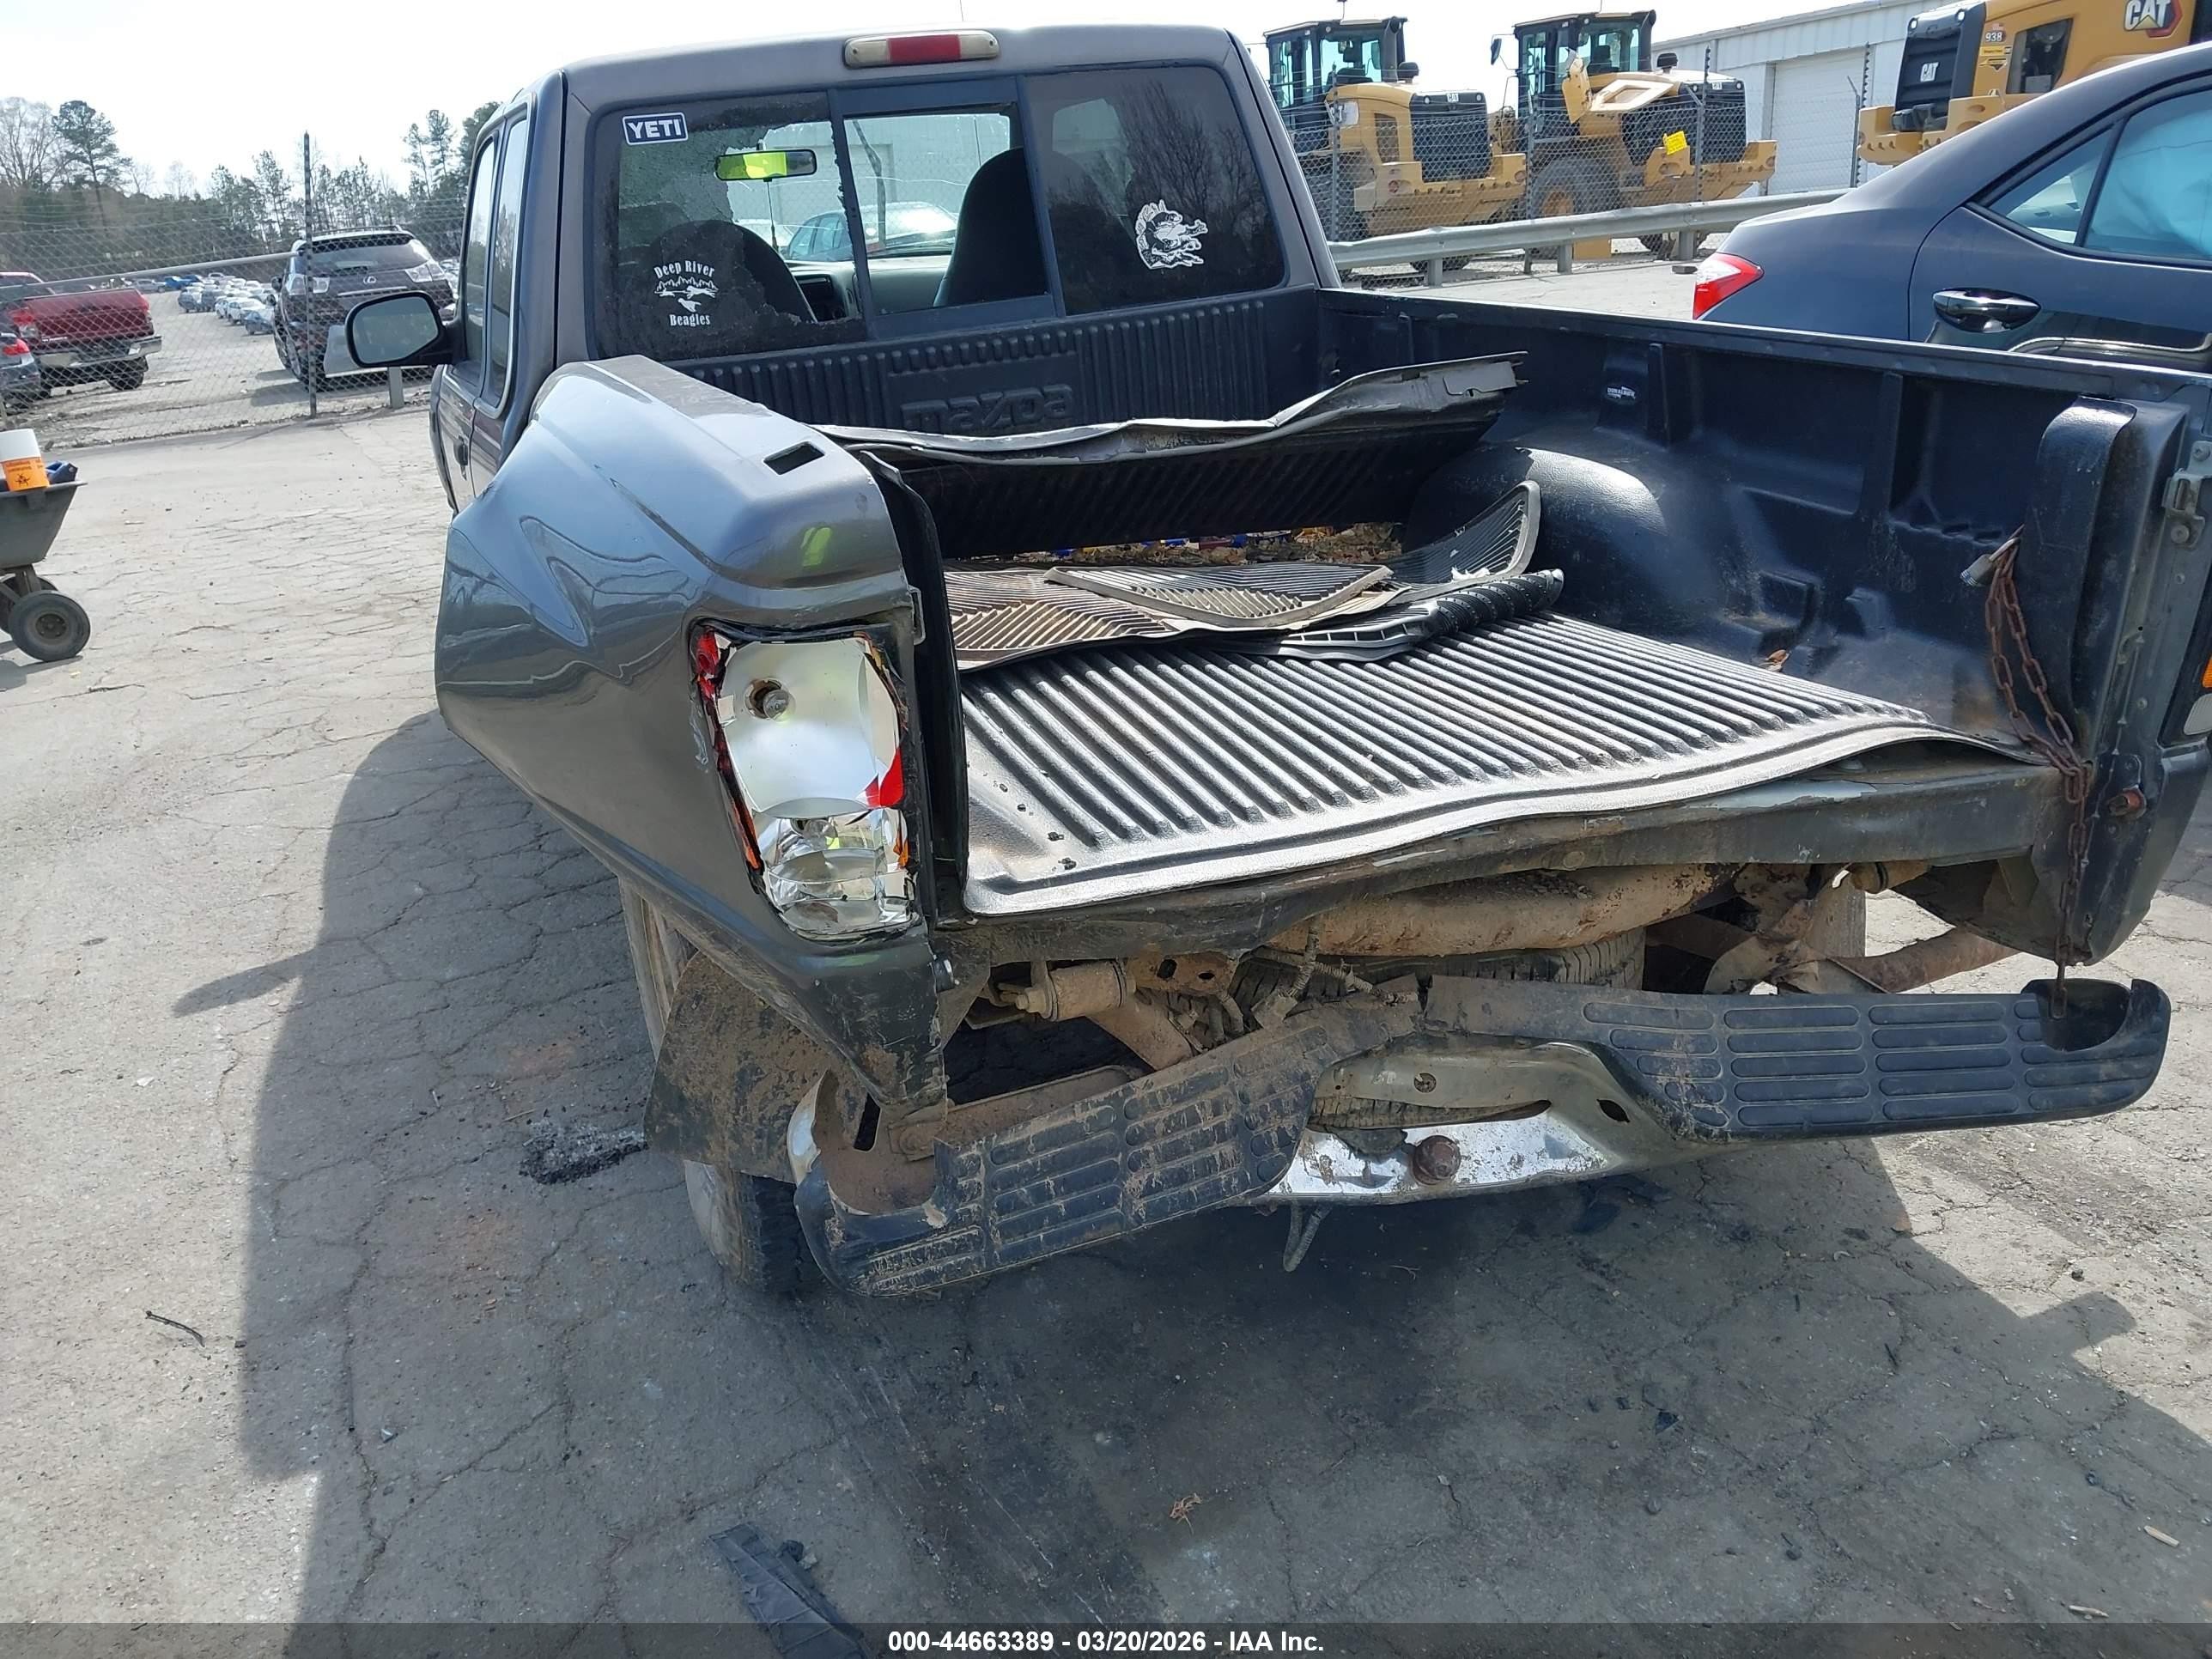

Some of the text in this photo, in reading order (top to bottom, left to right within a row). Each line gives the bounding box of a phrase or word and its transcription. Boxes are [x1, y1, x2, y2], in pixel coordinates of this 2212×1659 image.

[2124, 0, 2171, 30] CAT
[1984, 32, 2002, 42] 938
[1920, 62, 1939, 82] CAT
[1446, 93, 1459, 103] CAT
[628, 118, 682, 139] YETI
[653, 260, 715, 278] Deep River
[669, 314, 710, 327] Beagles
